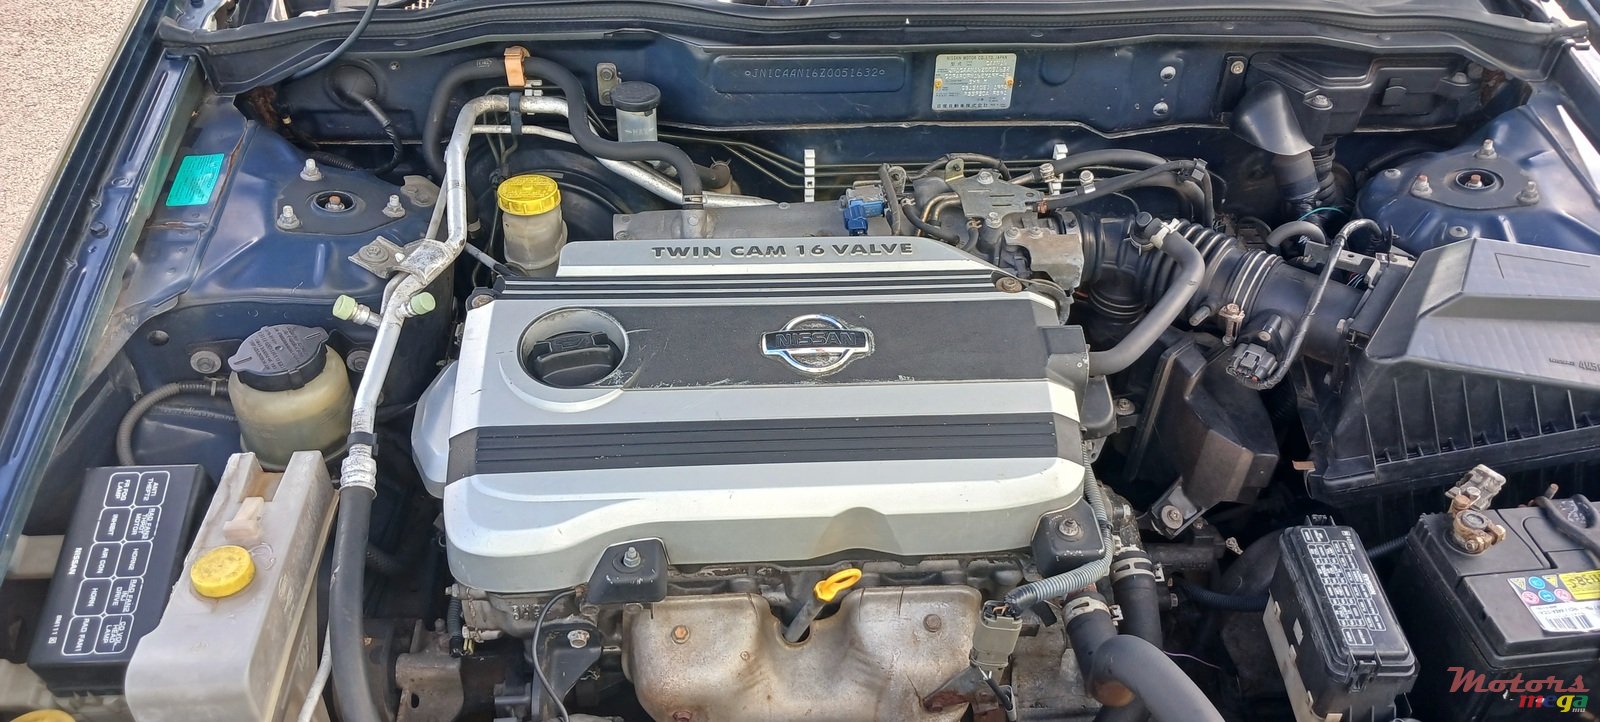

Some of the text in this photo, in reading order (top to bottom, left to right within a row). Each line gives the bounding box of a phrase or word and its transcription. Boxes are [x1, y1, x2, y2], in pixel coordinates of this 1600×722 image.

[652, 243, 913, 258] TWIN CAM 16 VALVE
[776, 332, 857, 348] NISSAN
[115, 482, 124, 498] LAMP
[108, 514, 118, 536] INHIBIT
[131, 513, 141, 535] MOTOR
[68, 547, 82, 575] NISSAN
[96, 548, 109, 573] AIR CON
[128, 548, 139, 570] HORN2
[88, 588, 98, 607] HORN
[112, 587, 122, 606] DRIVE
[75, 618, 90, 651] RAD FAN1
[103, 625, 112, 644] LAMP
[109, 624, 119, 643] HEAD
